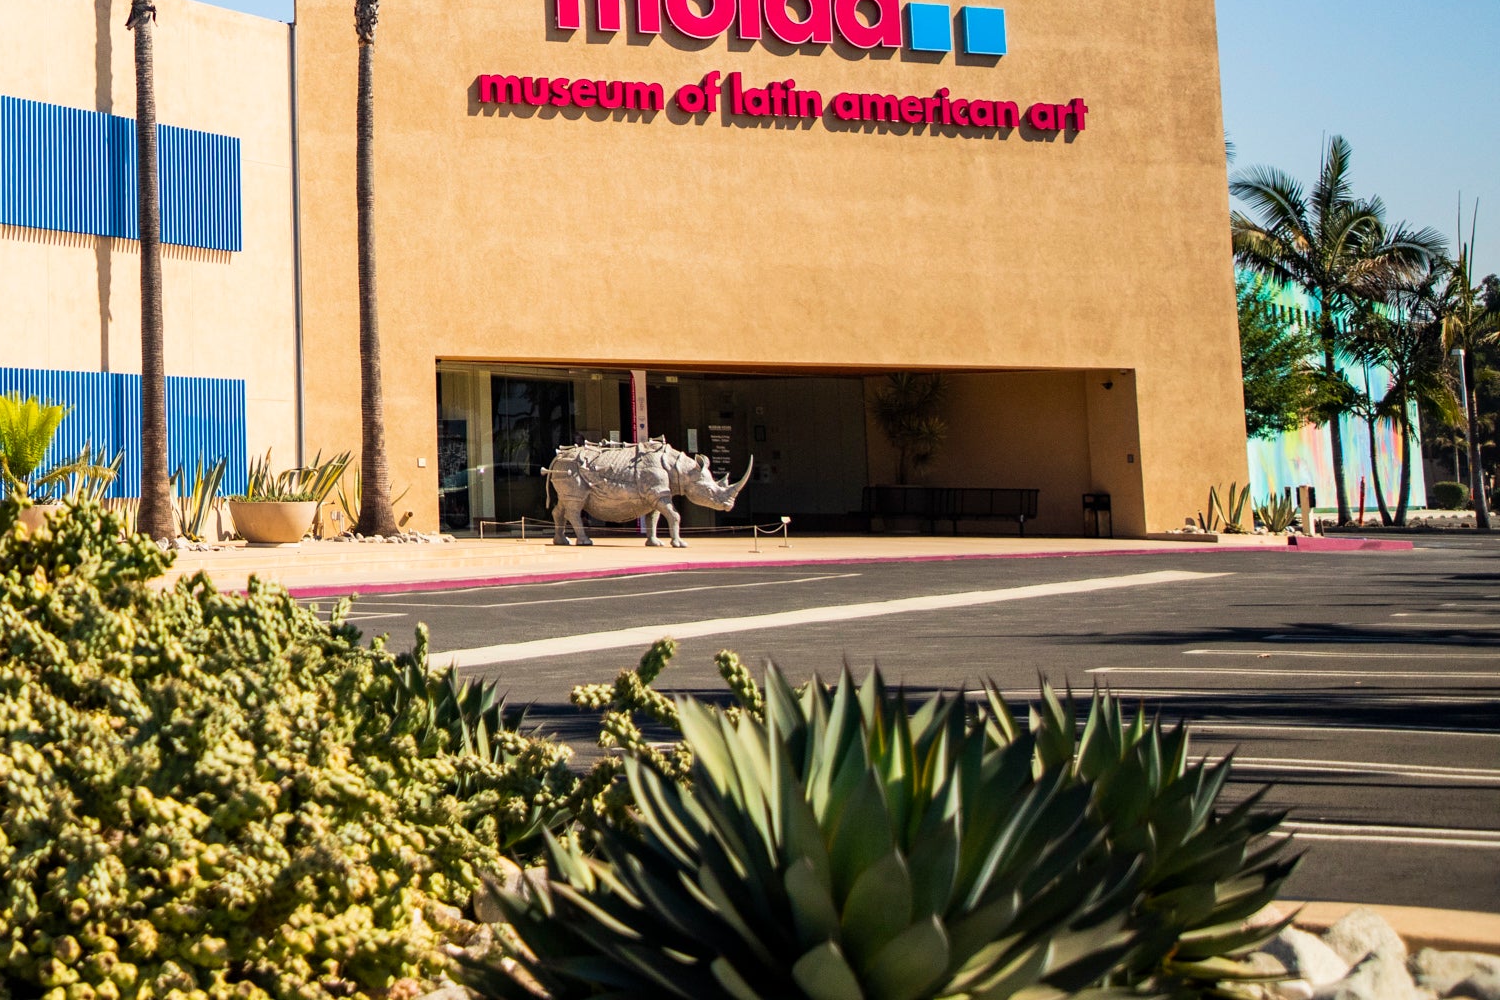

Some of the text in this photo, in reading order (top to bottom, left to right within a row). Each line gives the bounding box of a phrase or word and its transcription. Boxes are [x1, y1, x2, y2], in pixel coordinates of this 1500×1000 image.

[477, 70, 1089, 131] museum of latin american art
